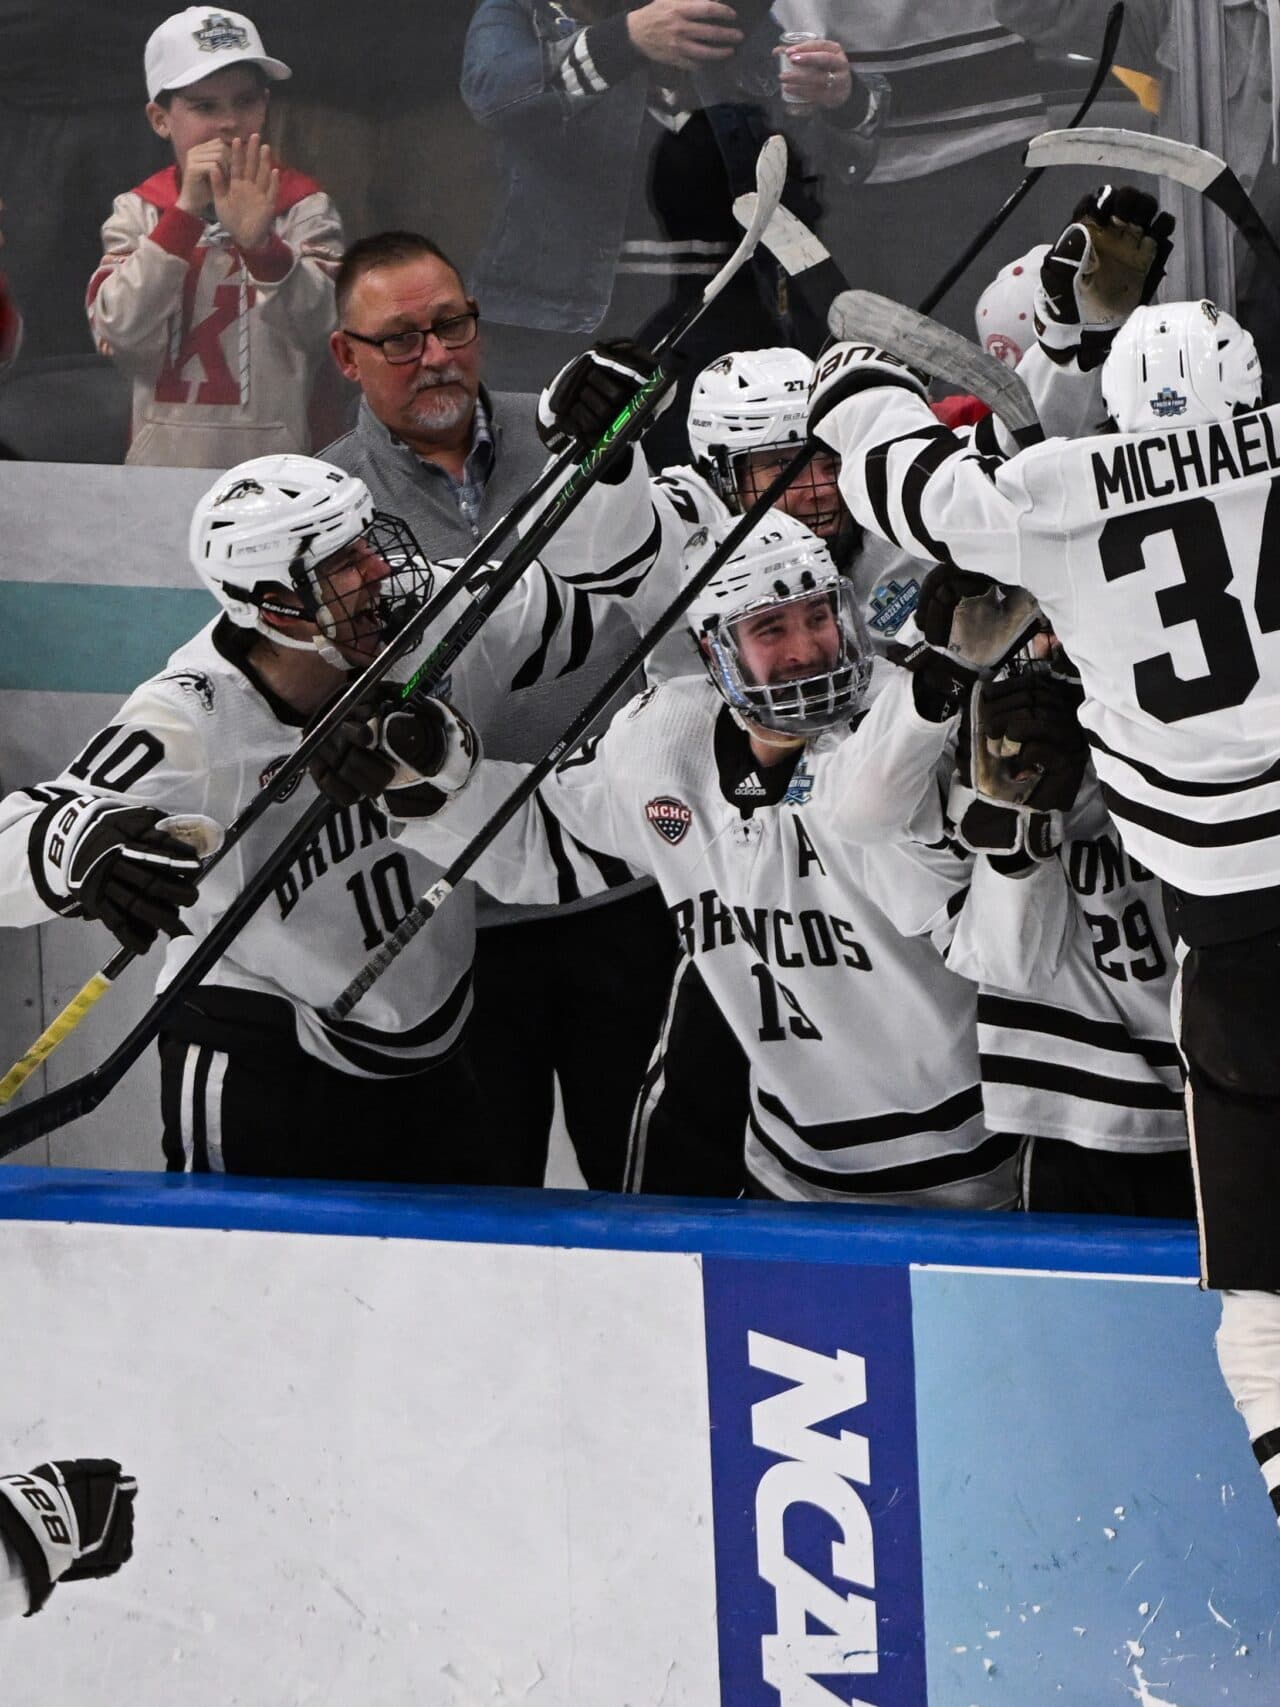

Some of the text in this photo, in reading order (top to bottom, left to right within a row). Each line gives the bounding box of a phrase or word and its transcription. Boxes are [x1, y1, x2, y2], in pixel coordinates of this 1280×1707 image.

[784, 380, 804, 392] 27
[877, 586, 918, 626] FROZEN FOUR
[69, 724, 165, 792] 10
[648, 805, 690, 821] NCHC
[735, 787, 766, 796] adidas
[792, 814, 827, 877] A
[347, 852, 415, 951] 10
[1084, 900, 1167, 982] 29
[747, 1330, 879, 1707] NCA
